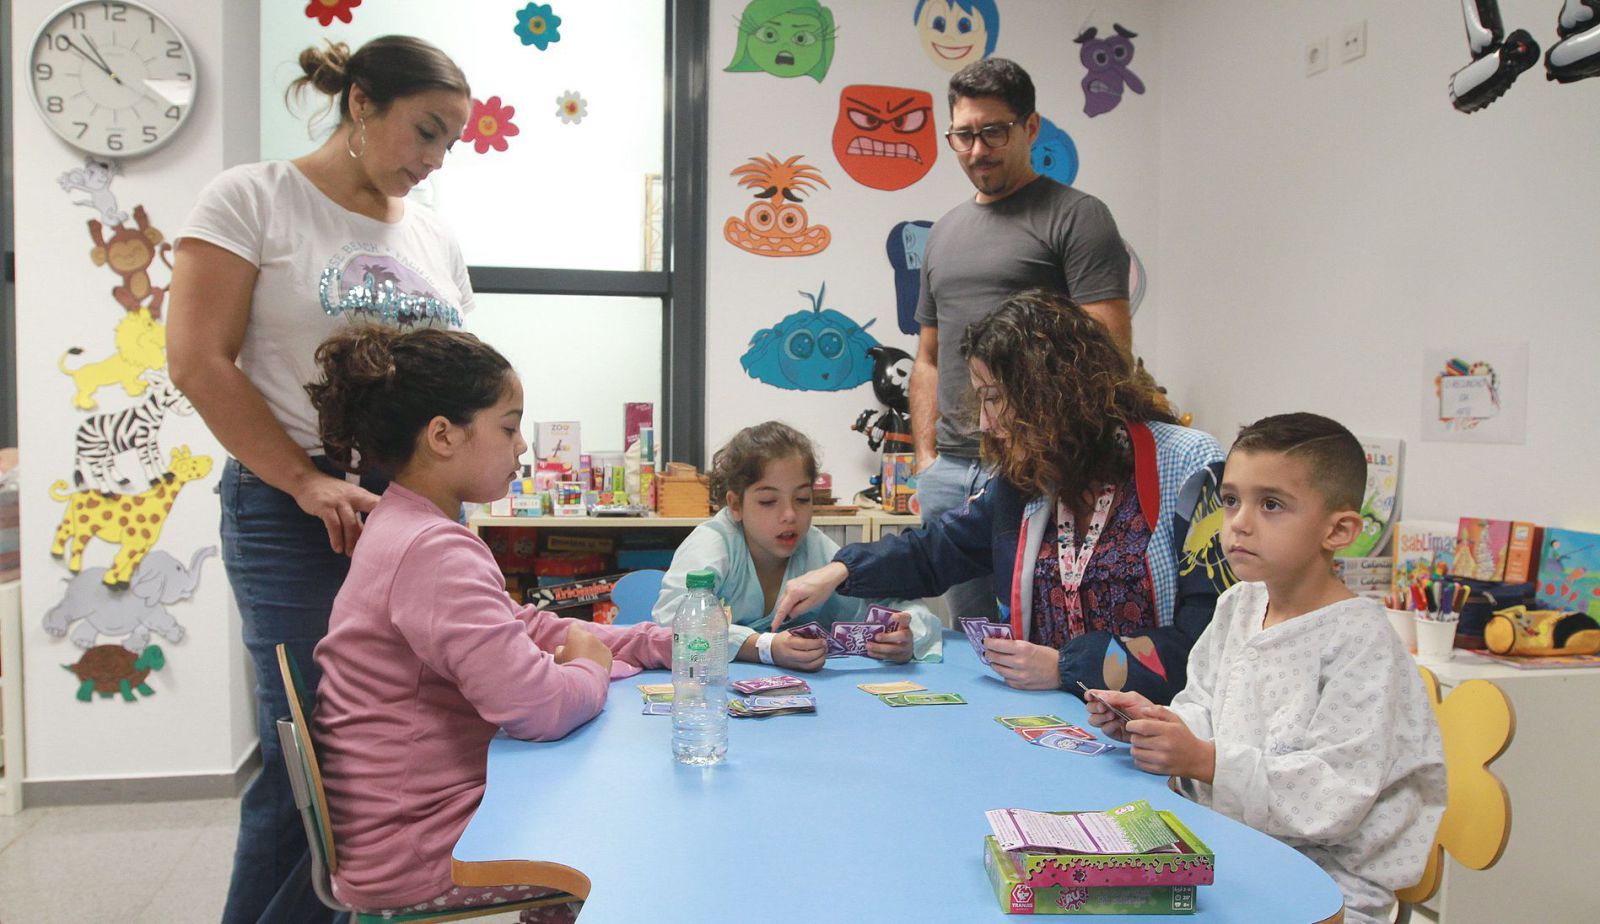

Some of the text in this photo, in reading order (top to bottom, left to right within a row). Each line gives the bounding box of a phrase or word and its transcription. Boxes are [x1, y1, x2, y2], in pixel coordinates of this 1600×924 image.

[103, 3, 127, 21] 12
[70, 12, 86, 30] 11
[148, 16, 156, 34] 1
[46, 33, 72, 51] 10
[166, 40, 183, 58] 2
[36, 63, 53, 80] 9
[47, 96, 64, 113] 8
[164, 105, 181, 121] 4
[72, 122, 89, 139] 7
[142, 126, 158, 143] 5
[106, 133, 124, 150] 6
